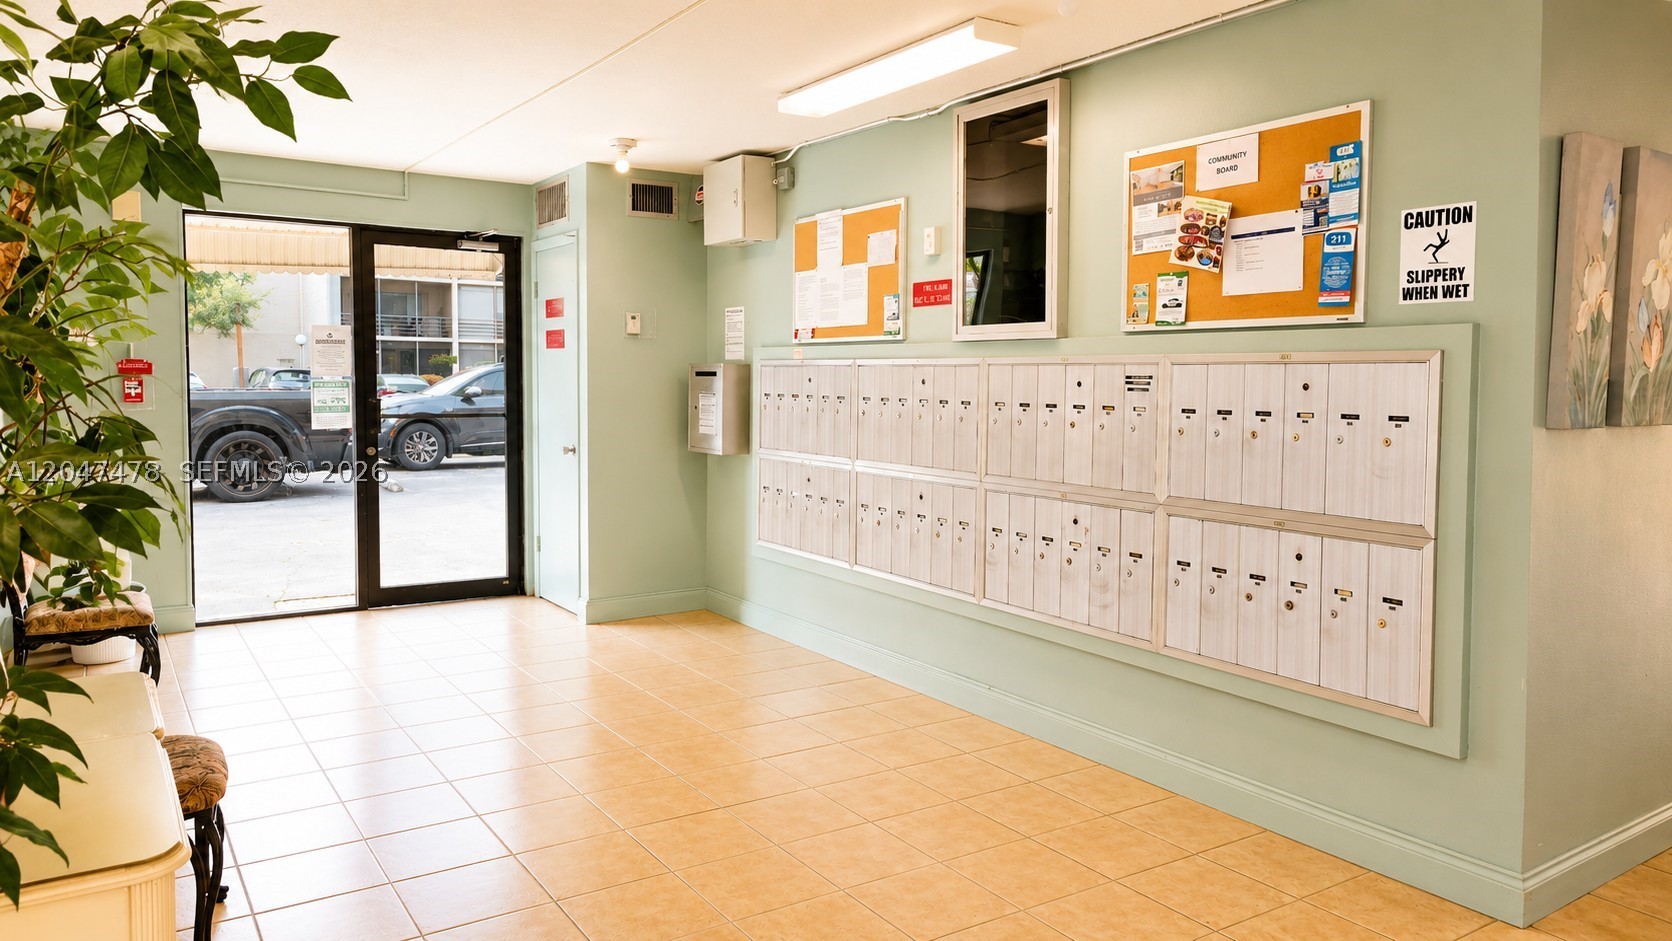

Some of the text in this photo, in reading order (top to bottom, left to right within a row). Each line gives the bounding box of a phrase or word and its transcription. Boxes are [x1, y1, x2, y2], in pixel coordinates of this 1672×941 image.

[1208, 151, 1247, 164] COMMUNITY
[1216, 164, 1238, 174] BOARD
[1404, 205, 1473, 230] CAUTION
[1331, 235, 1346, 244] 211
[1406, 266, 1466, 284] SLIPPERY
[1402, 283, 1470, 301] WHEN WET
